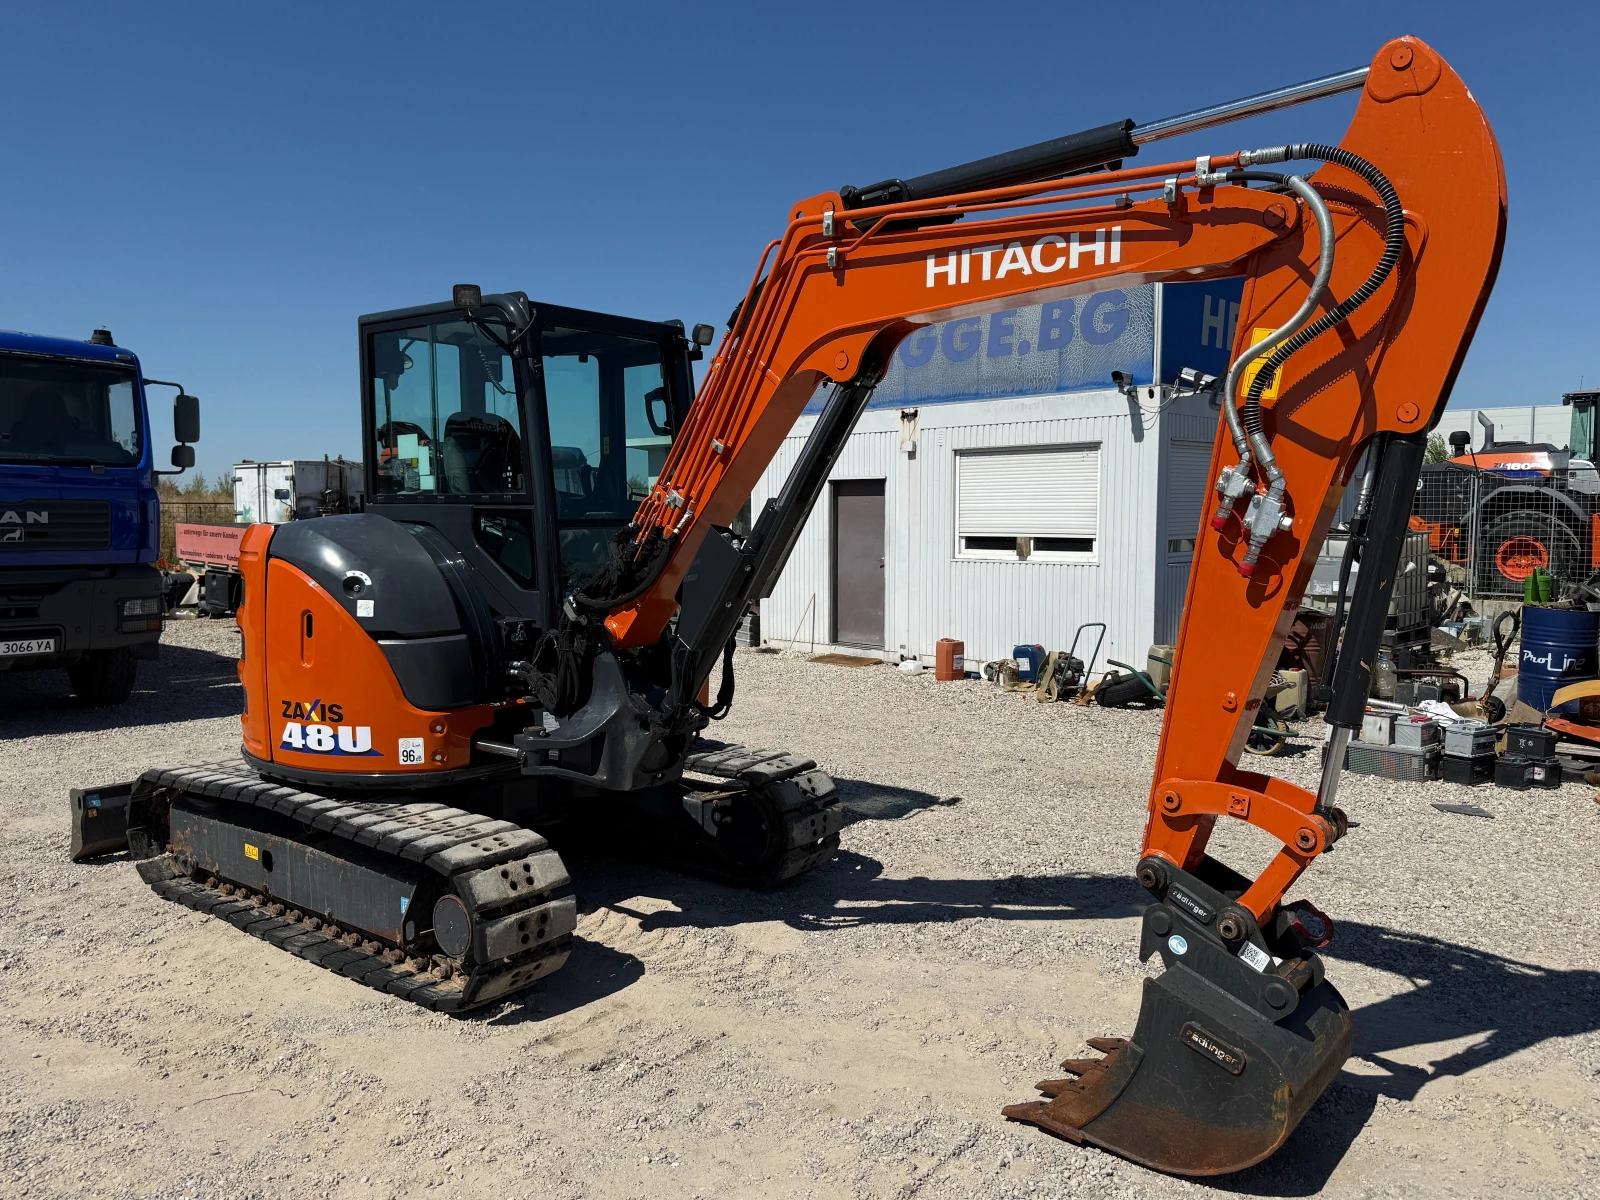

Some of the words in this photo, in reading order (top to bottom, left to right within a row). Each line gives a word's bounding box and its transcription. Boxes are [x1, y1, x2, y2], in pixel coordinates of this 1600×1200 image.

[926, 225, 1121, 288] HITACHI
[889, 288, 1130, 369] GGE.BG
[0, 511, 48, 523] AN
[223, 531, 238, 539] Kunden
[3, 641, 33, 653] 3066
[281, 699, 344, 723] ZAXIS
[282, 721, 372, 753] 48U
[402, 749, 415, 762] 96
